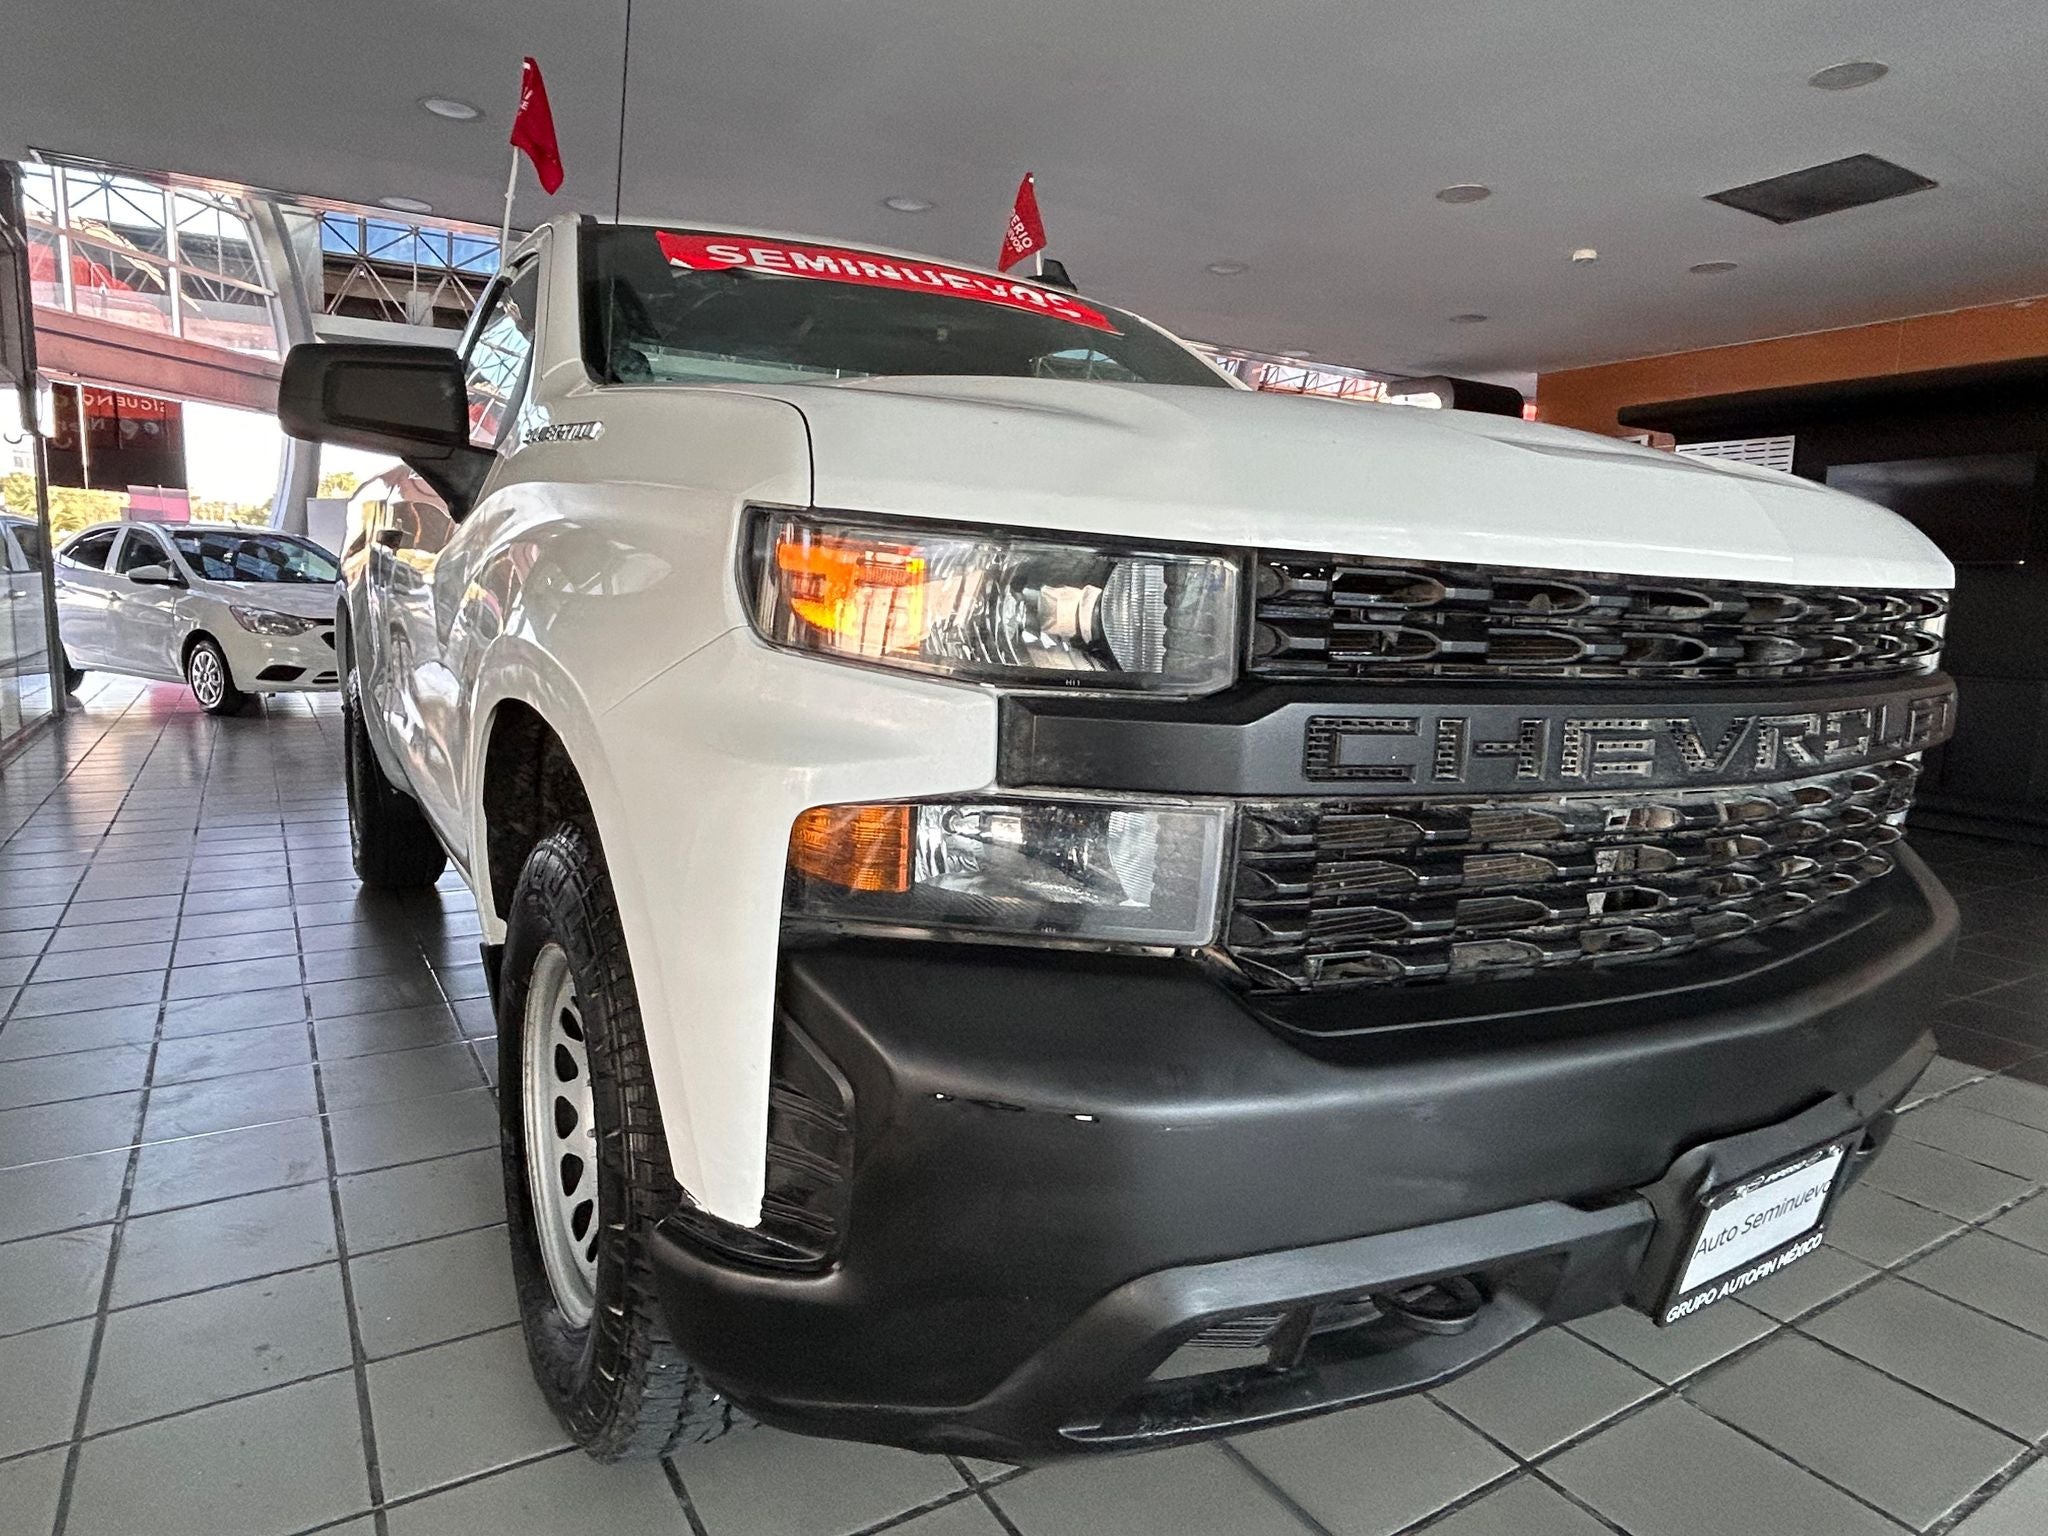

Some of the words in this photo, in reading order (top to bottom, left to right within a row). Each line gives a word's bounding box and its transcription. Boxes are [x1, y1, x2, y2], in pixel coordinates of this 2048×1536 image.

[705, 244, 1082, 318] SEMINUEVOS
[1692, 1226, 1738, 1261] Auto
[1666, 1288, 1717, 1324] GRUPO
[1716, 1259, 1776, 1299] AUTOFIN
